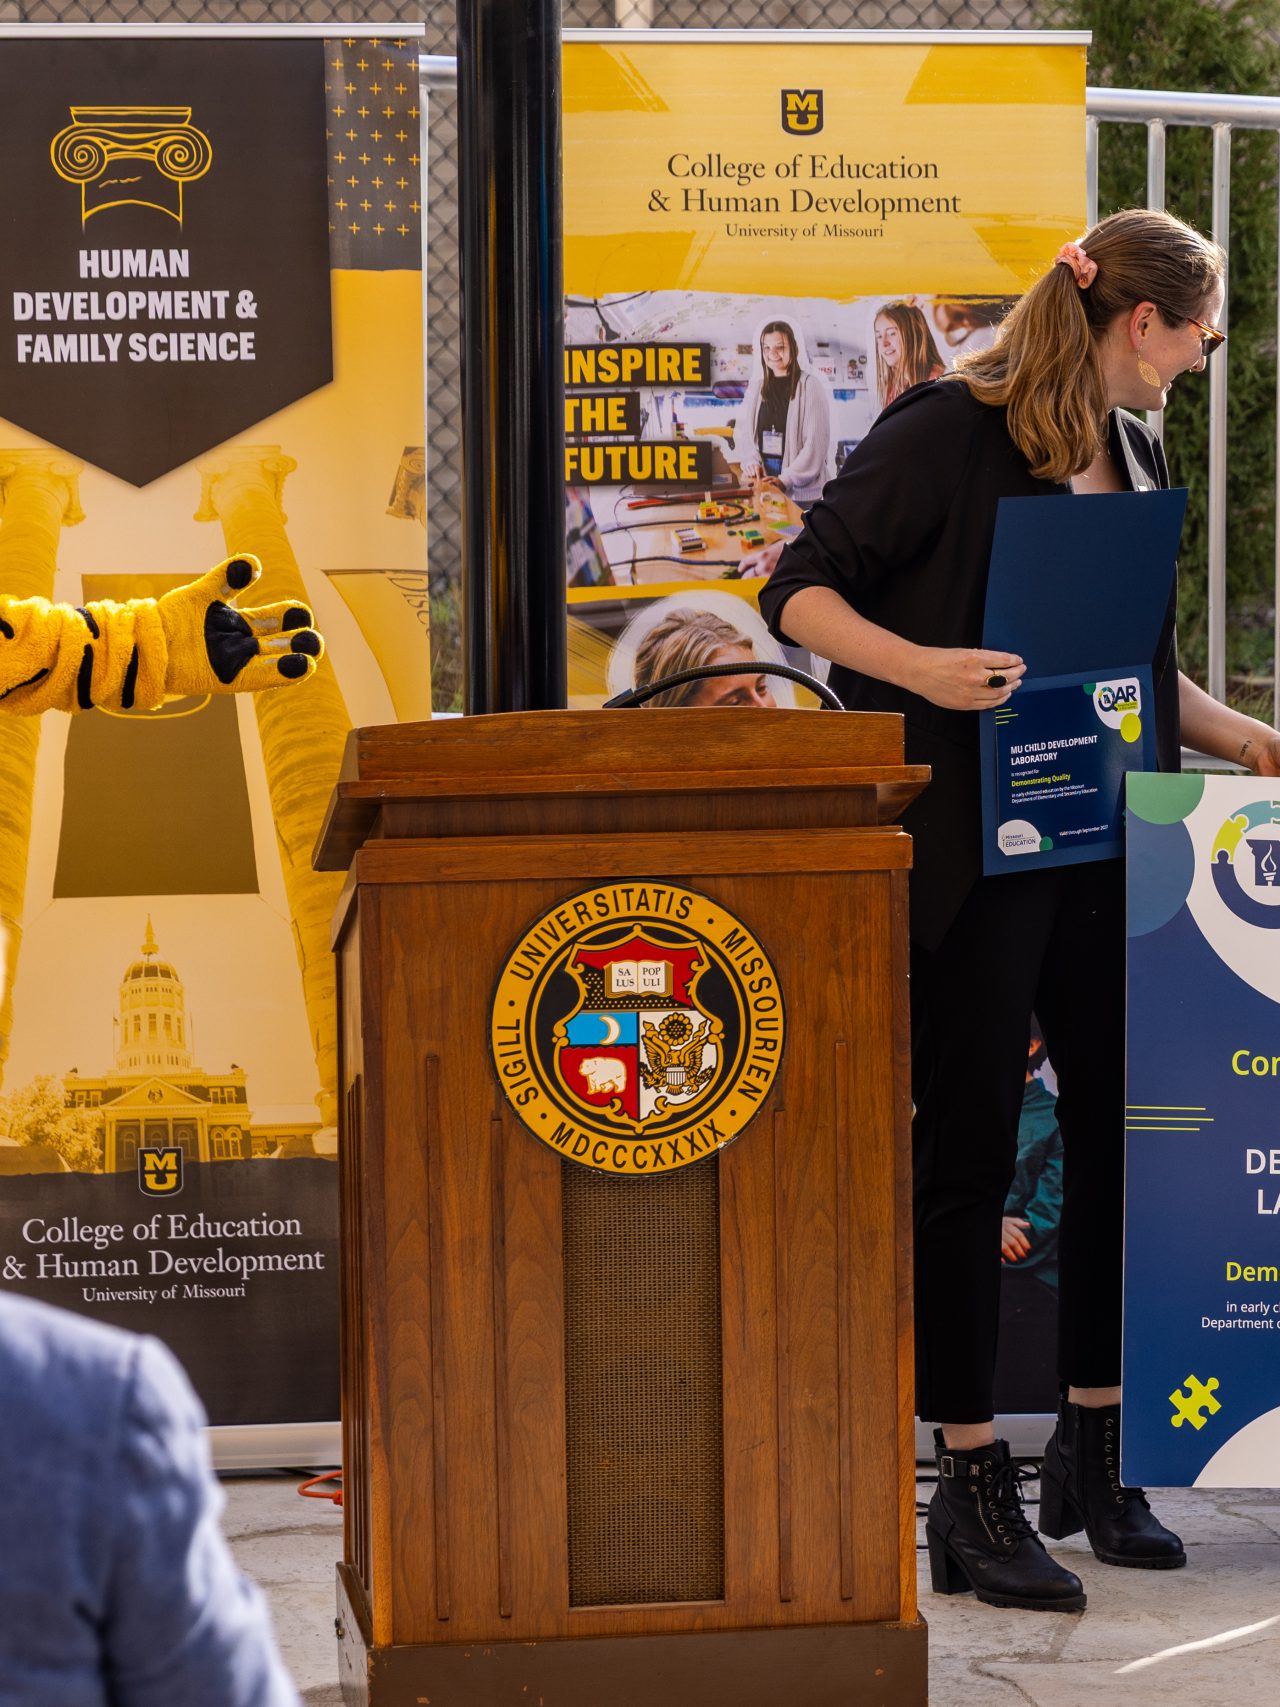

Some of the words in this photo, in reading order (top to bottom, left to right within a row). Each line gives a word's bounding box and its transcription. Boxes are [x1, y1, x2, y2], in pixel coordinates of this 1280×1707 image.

[667, 153, 765, 186] College
[775, 154, 803, 178] of
[808, 155, 939, 179] Education
[648, 189, 671, 212] &
[681, 188, 780, 213] Human
[790, 189, 962, 221] Development
[725, 223, 797, 241] University
[803, 224, 818, 237] of
[823, 223, 884, 238] Missouri
[79, 249, 190, 278] HUMAN
[13, 290, 230, 321] DEVELOPMENT
[235, 289, 258, 319] &
[17, 333, 123, 363] FAMILY
[128, 331, 256, 362] SCIENCE
[564, 348, 702, 384] INSPIRE
[565, 397, 627, 433] THE
[565, 446, 698, 481] FUTURE
[1098, 685, 1137, 712] QAR
[1010, 745, 1023, 755] MU
[1024, 742, 1046, 753] CHILD
[1048, 735, 1098, 750] DEVELOPMENT
[1011, 752, 1058, 766] LABORATORY
[1011, 776, 1052, 787] Demonstrating
[1052, 773, 1071, 782] Quality
[1005, 838, 1036, 848] EDUCATION
[509, 888, 693, 981] UNIVERSITATIS
[616, 978, 635, 987] LUS
[617, 967, 631, 976] SA
[642, 966, 661, 976] POP
[643, 978, 660, 987] ULI
[721, 927, 779, 1101] MISSOURIEN
[497, 1018, 539, 1106] SIGILL
[550, 1119, 726, 1169] MDCCCXXXIX
[22, 1217, 124, 1250] College
[133, 1214, 162, 1240] of
[167, 1212, 303, 1239] Education
[2, 1255, 27, 1280] &
[36, 1253, 140, 1279] Human
[148, 1247, 325, 1280] Development
[82, 1286, 157, 1304] University
[161, 1285, 178, 1299] of
[182, 1283, 246, 1299] Missouri
[1226, 1301, 1237, 1313] in
[1241, 1301, 1270, 1316] early
[1201, 1317, 1274, 1331] Department
